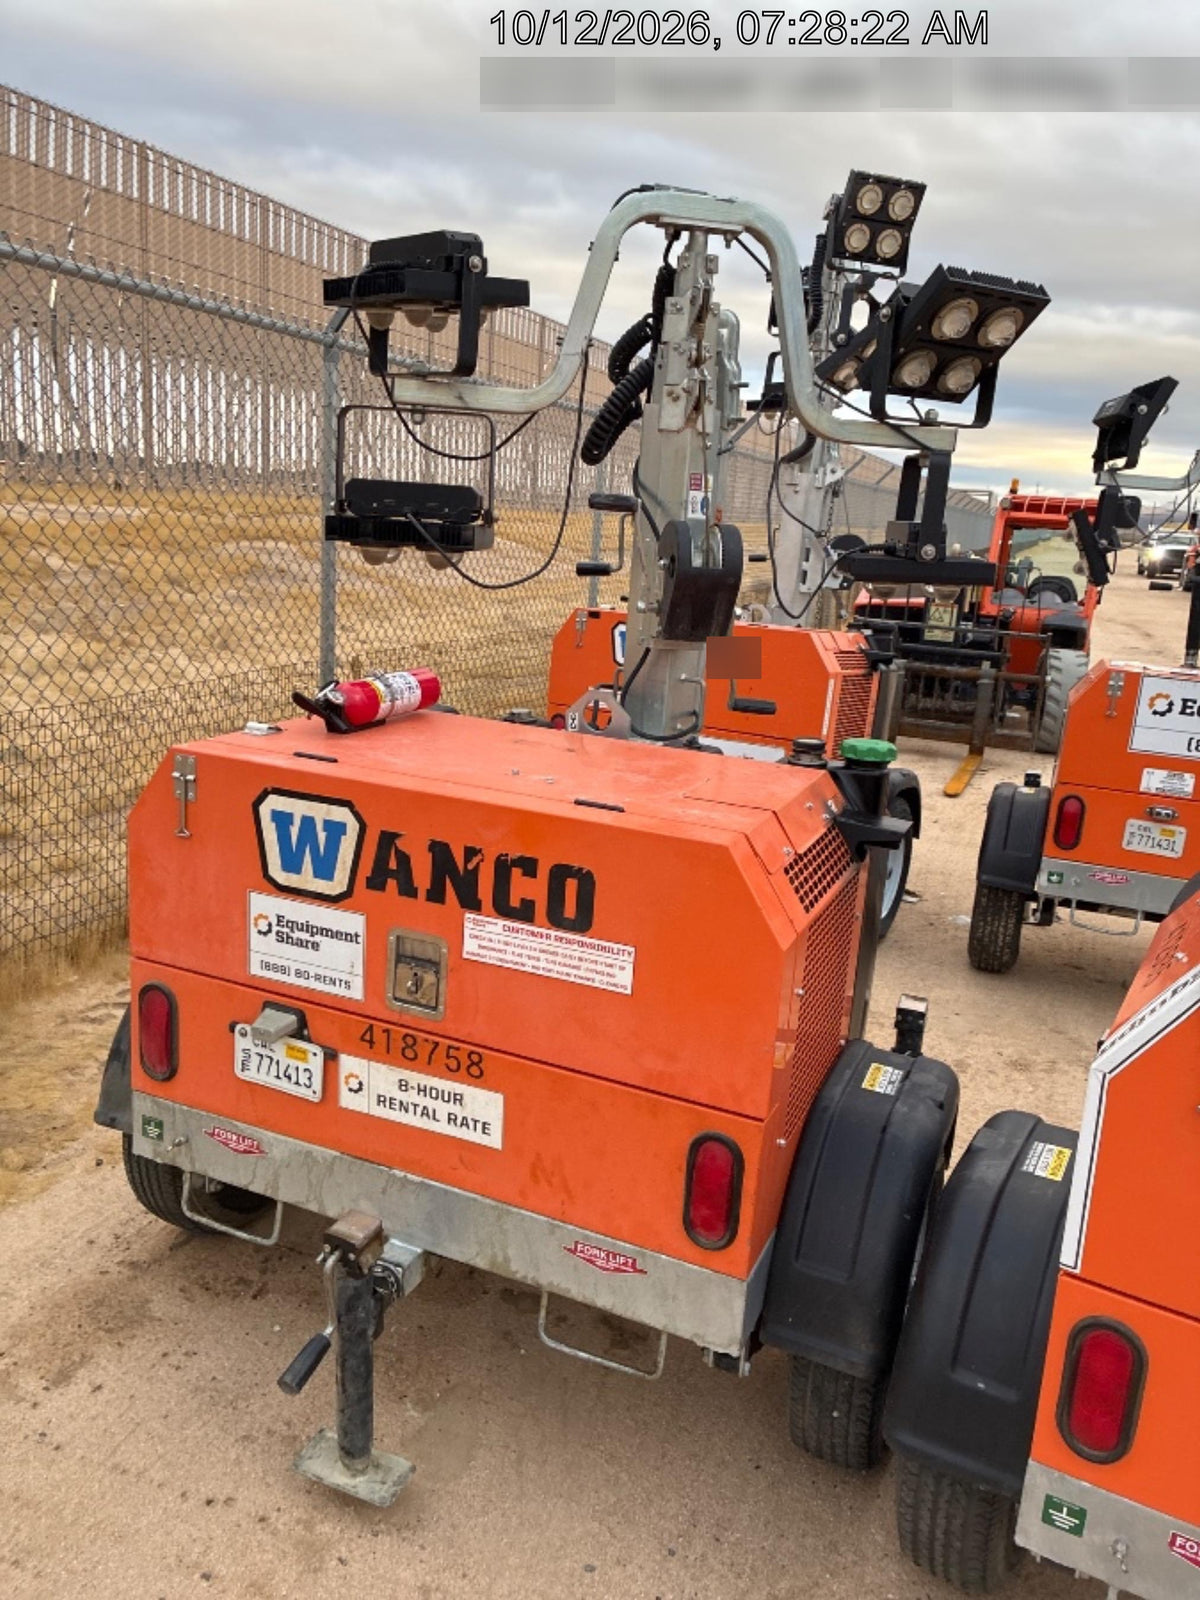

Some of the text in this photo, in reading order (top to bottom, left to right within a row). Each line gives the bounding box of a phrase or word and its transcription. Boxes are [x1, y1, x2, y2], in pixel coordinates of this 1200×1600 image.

[1137, 833, 1177, 852] 771431
[270, 808, 597, 934] WANCO
[275, 913, 362, 944] Equipment
[275, 930, 320, 951] Share
[260, 959, 351, 990] (888) 80-RENTS
[359, 1023, 485, 1080] 418758
[254, 1052, 314, 1089] 771413
[397, 1078, 464, 1107] 8-HOUR
[376, 1094, 492, 1136] RENTAL RATE
[1175, 1536, 1200, 1556] FO
